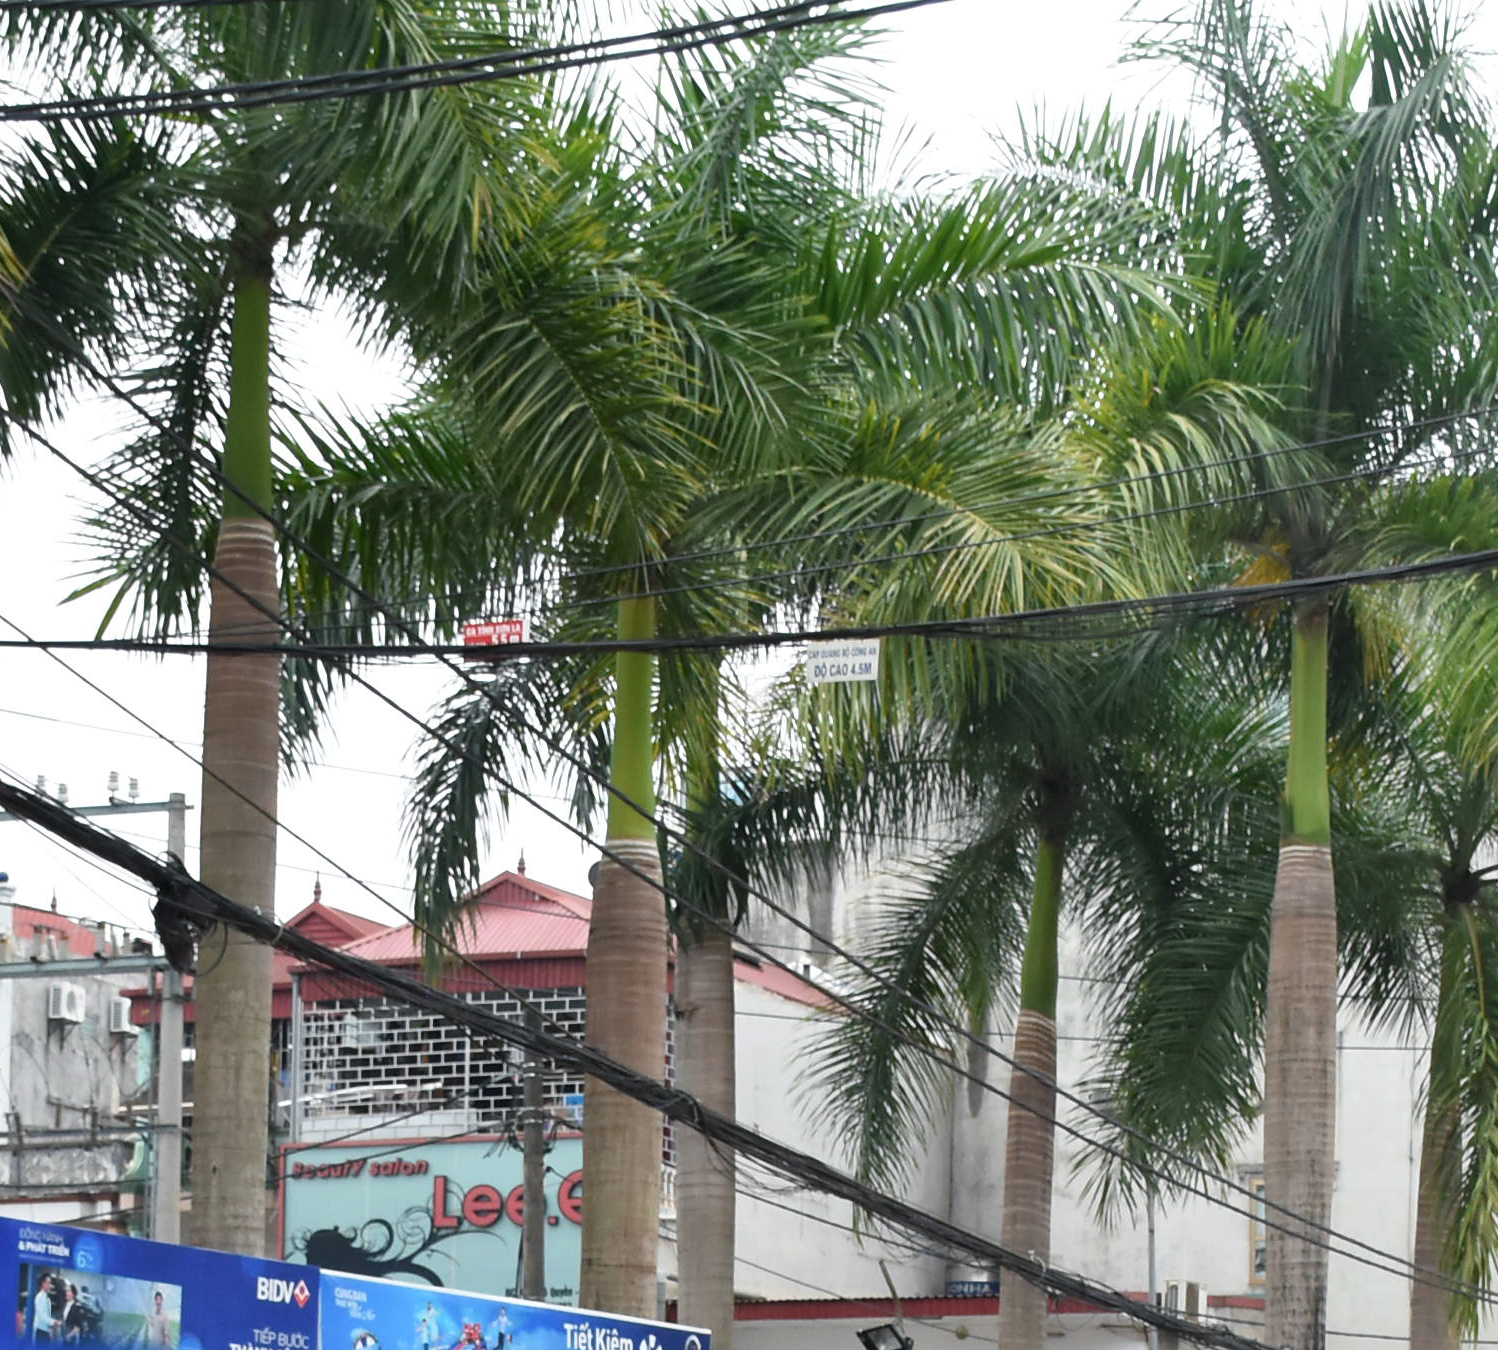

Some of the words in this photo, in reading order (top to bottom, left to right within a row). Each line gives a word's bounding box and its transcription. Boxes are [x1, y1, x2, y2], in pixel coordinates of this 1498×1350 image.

[829, 663, 848, 677] CAO
[368, 1157, 429, 1177] salon
[256, 1276, 295, 1305] BIDV
